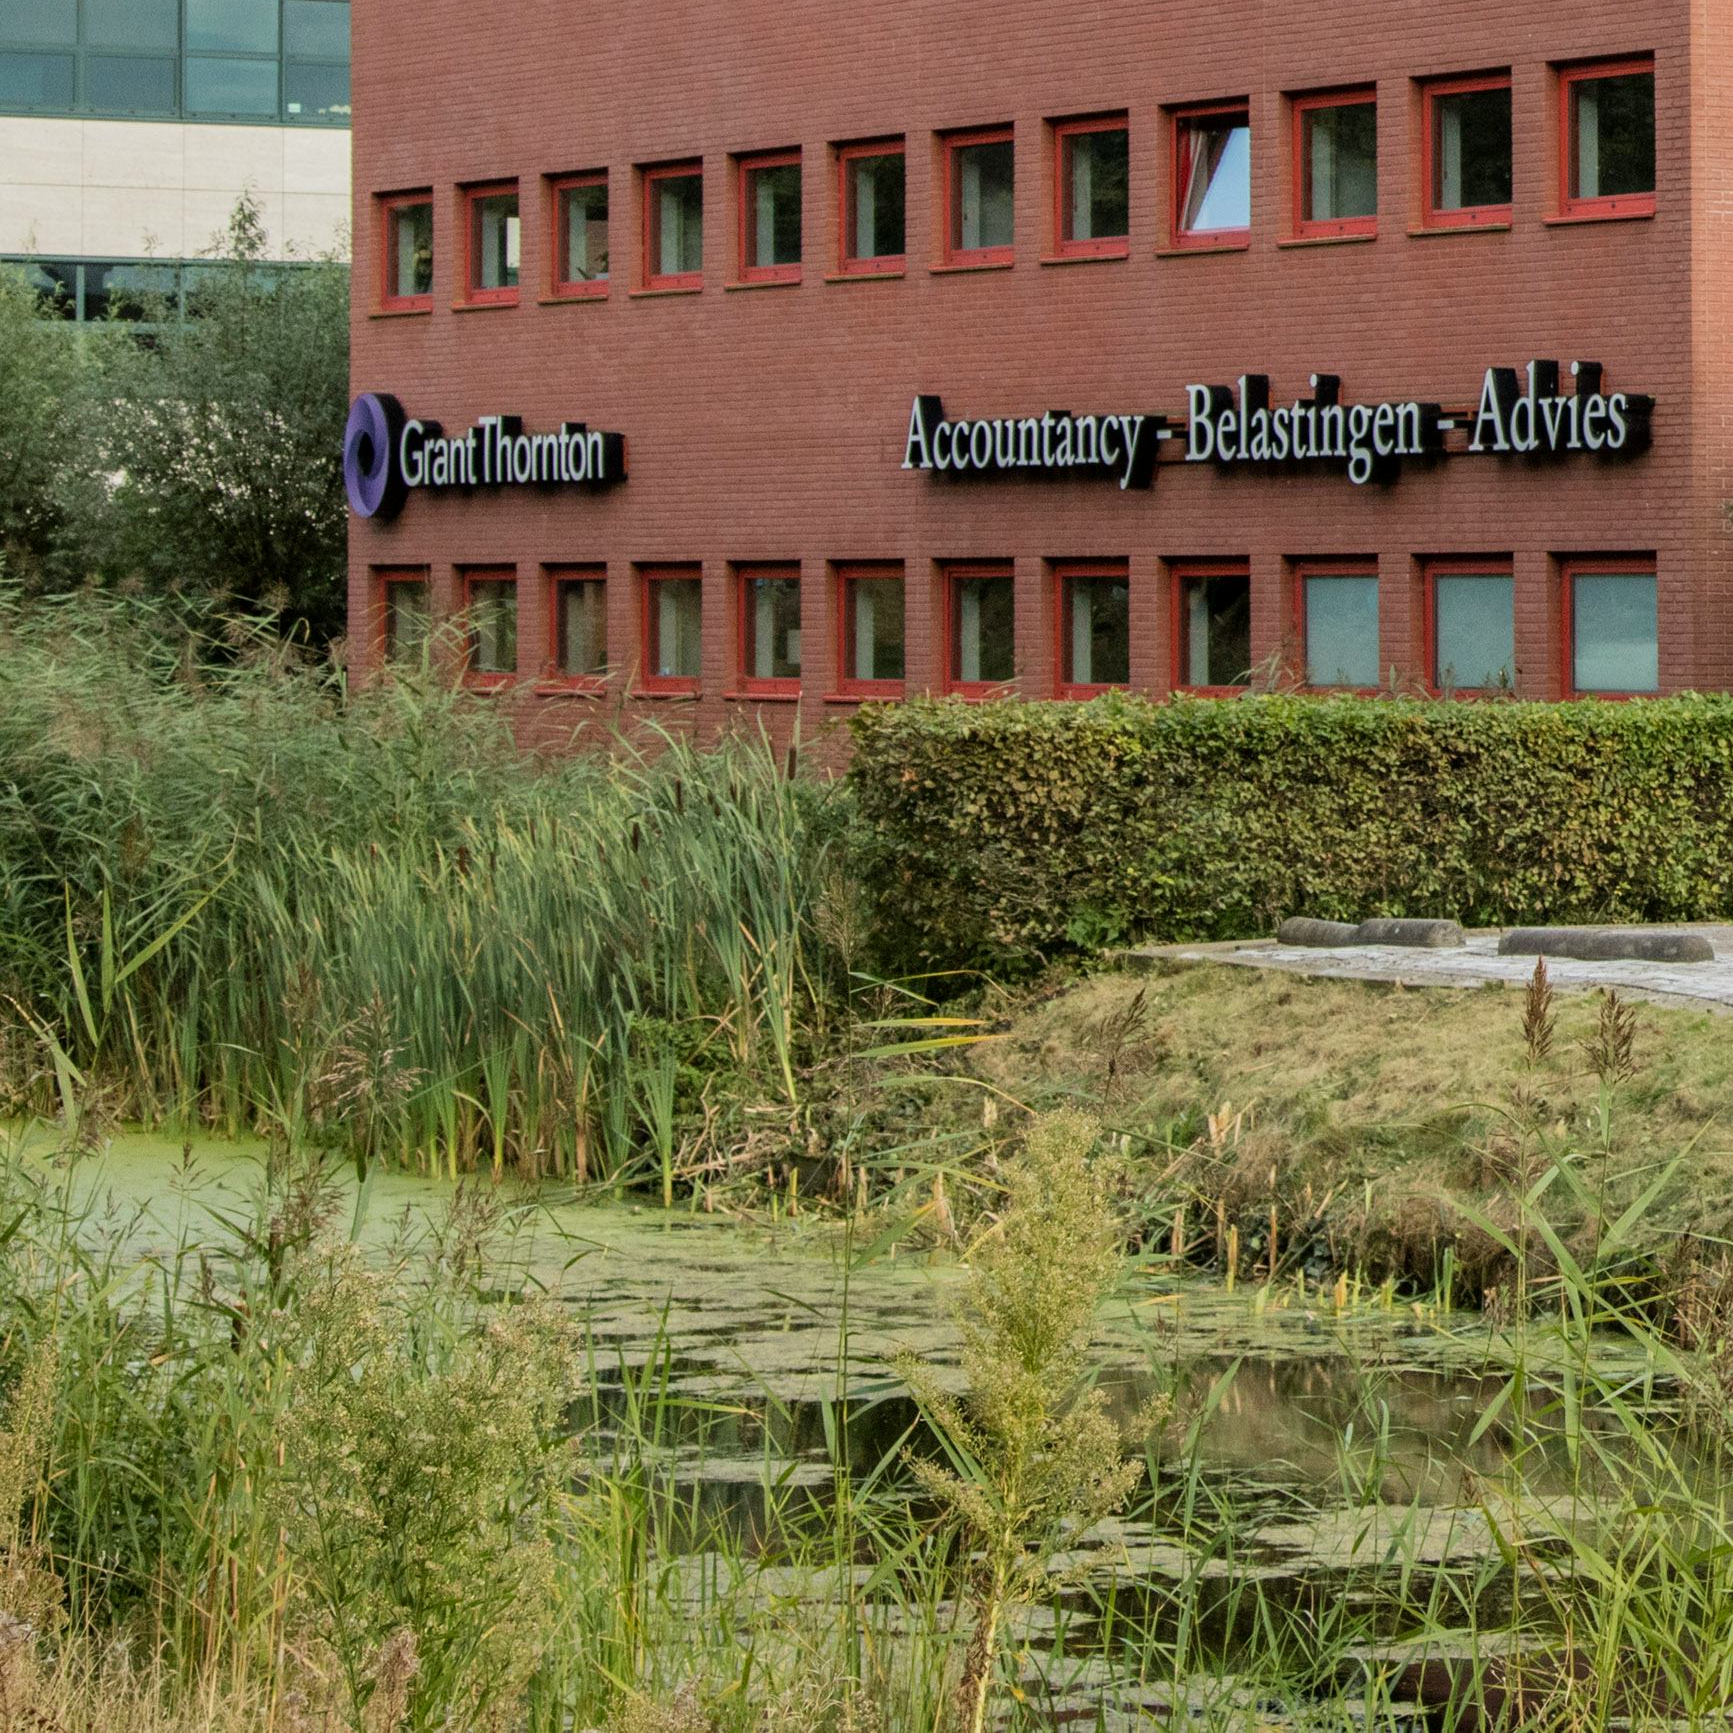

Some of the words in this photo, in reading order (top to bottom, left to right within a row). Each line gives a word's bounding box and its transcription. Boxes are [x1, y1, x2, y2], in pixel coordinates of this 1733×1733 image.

[401, 419, 478, 486] Grant
[478, 415, 604, 483] Thornton
[901, 395, 1144, 490] Accountancy
[1186, 374, 1423, 484] Belastingen
[1469, 359, 1629, 452] Advies
